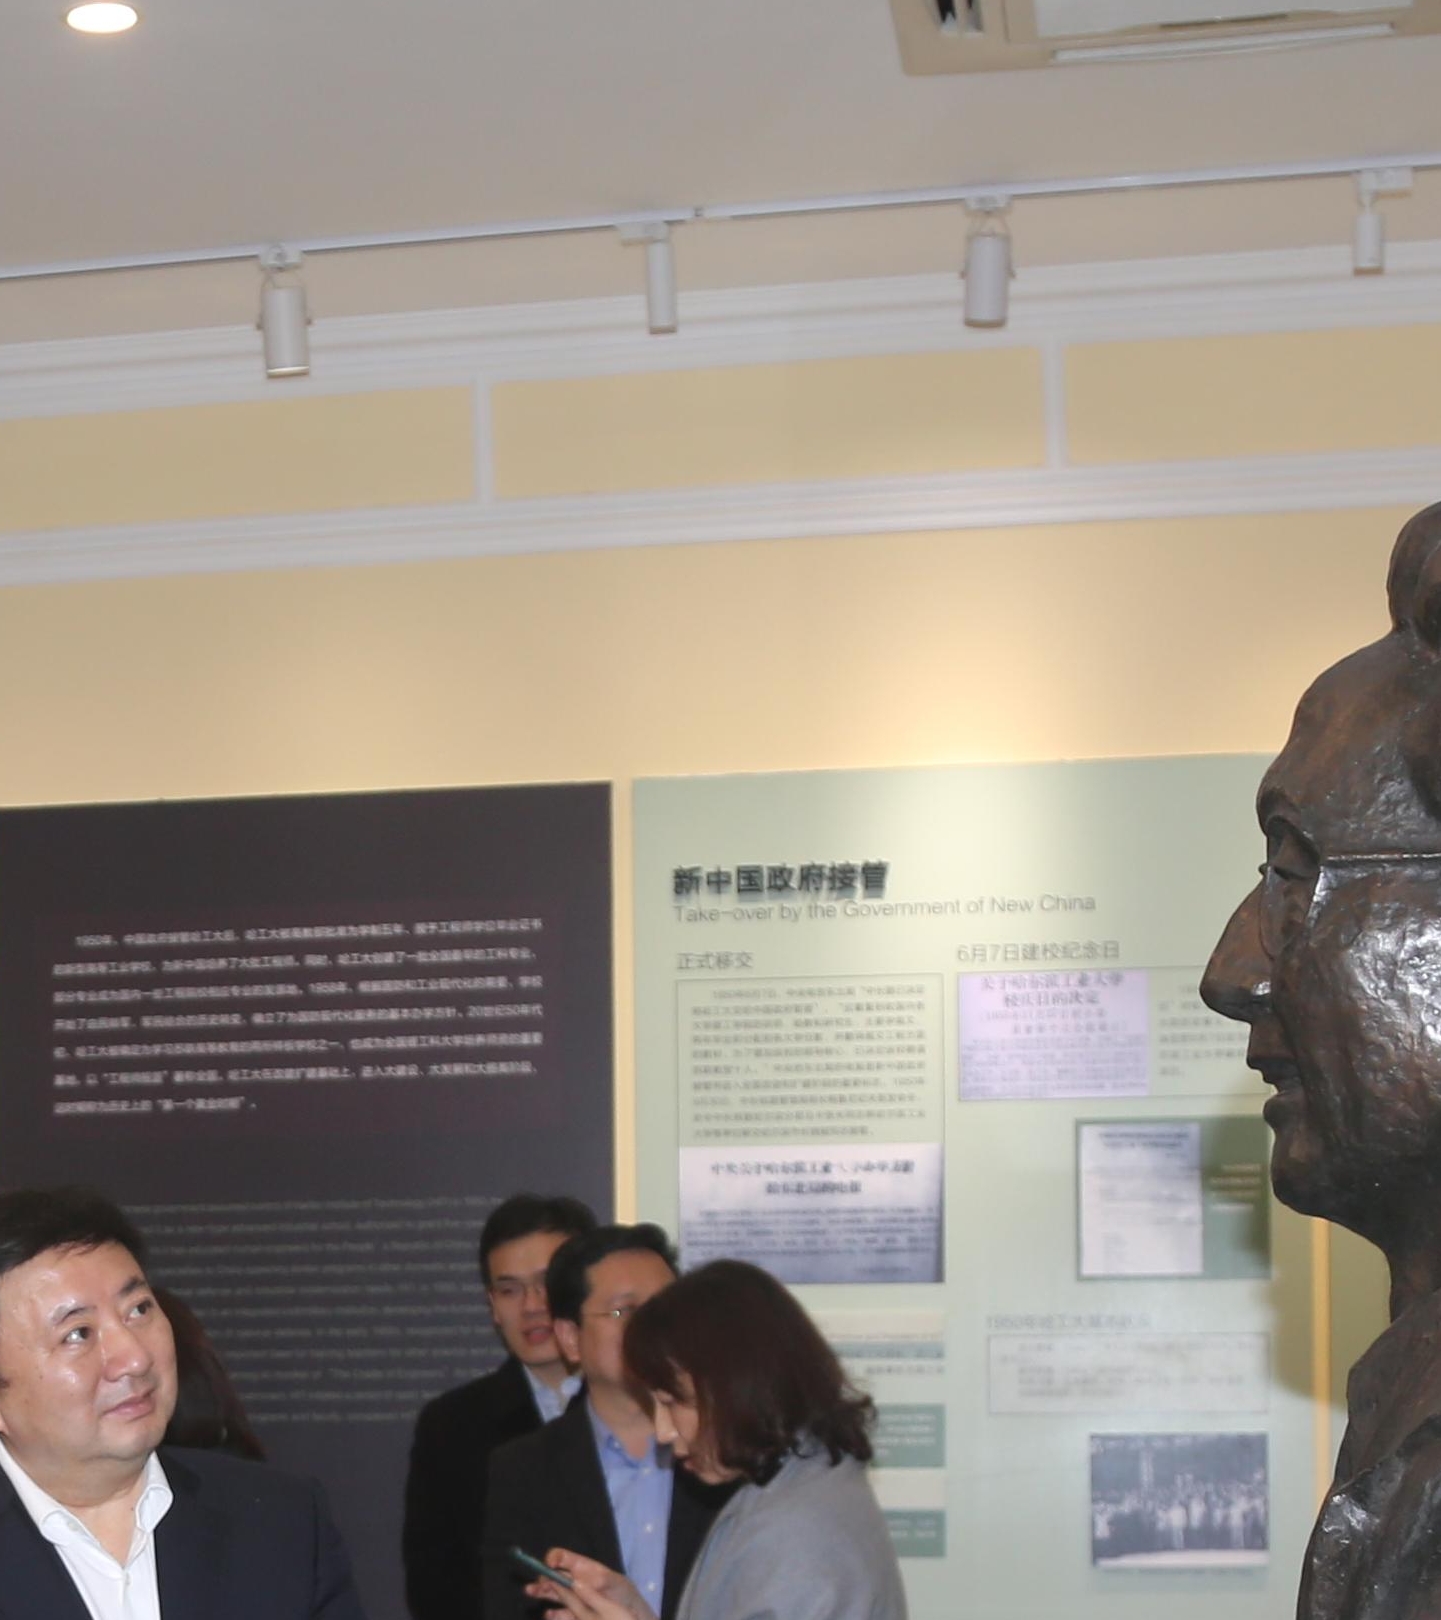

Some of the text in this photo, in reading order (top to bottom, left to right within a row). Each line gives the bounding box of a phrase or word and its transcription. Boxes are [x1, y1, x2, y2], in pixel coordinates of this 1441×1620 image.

[673, 860, 889, 896] 新中国政府接管
[781, 903, 801, 923] by
[808, 901, 837, 918] the
[844, 898, 963, 919] Government
[968, 898, 985, 914] of
[992, 897, 1034, 913] New
[1041, 893, 1096, 912] China
[957, 940, 1120, 962] 6月7日建校纪念日
